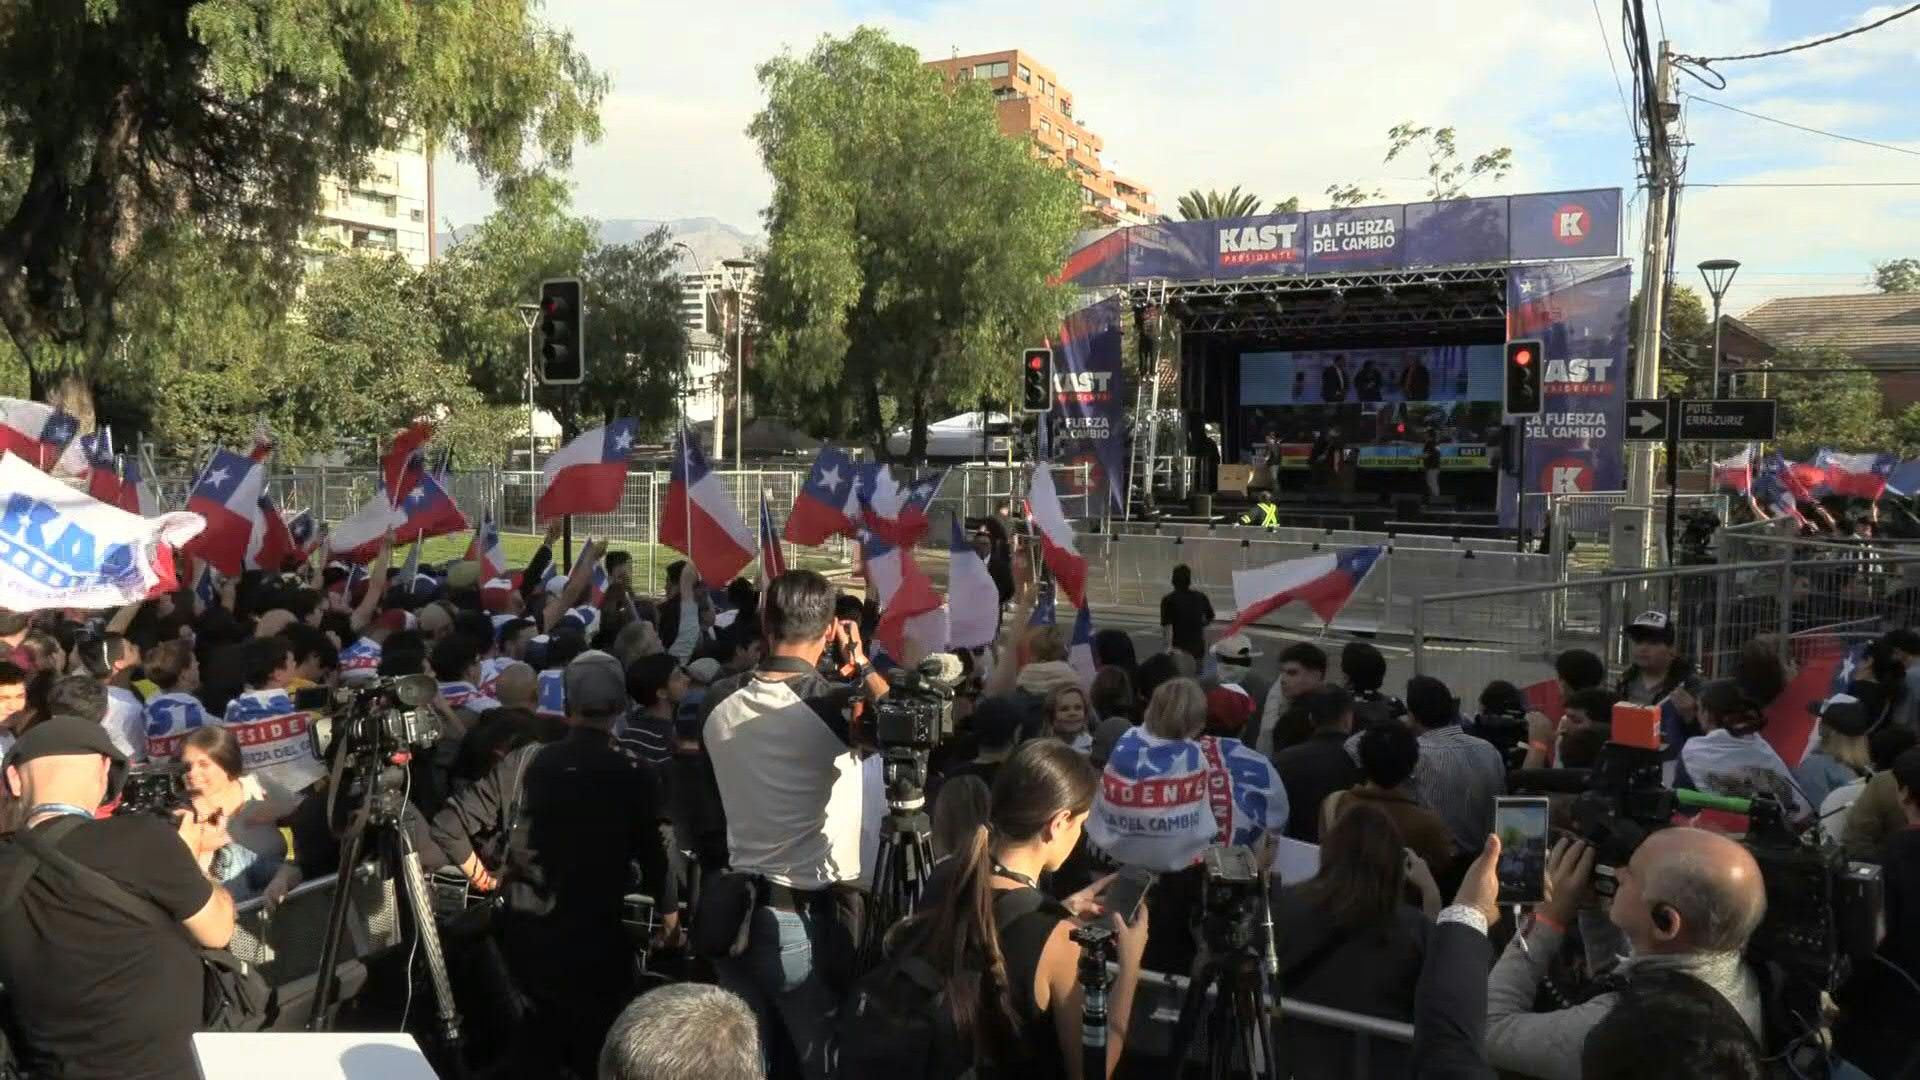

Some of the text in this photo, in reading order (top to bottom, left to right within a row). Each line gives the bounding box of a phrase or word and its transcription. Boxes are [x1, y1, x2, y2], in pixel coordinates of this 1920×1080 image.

[1313, 219, 1395, 239] LA FUERZA
[1560, 212, 1584, 237] K
[1220, 223, 1297, 253] KAST
[1313, 235, 1395, 253] DEL CAMBIO
[1224, 251, 1292, 263] PRESIDENTE
[1544, 358, 1613, 383] AST
[1065, 417, 1109, 429] FUERZA
[1546, 413, 1606, 426] FUERZA
[1685, 415, 1745, 427] ERRAZURIZ
[1552, 427, 1606, 439] CAMBIO
[1551, 467, 1583, 494] K
